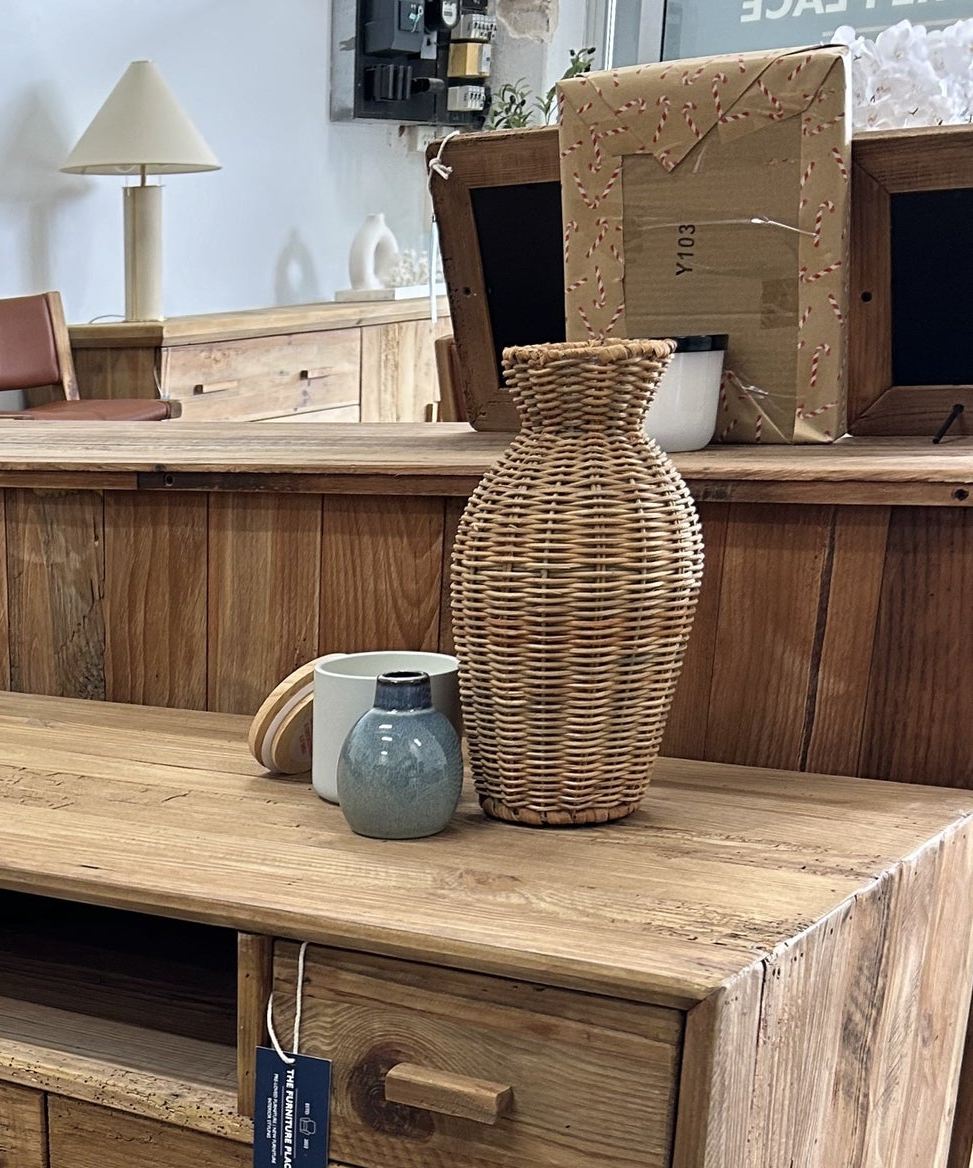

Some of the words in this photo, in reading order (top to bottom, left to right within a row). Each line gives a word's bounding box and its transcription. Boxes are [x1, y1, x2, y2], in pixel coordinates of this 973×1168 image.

[675, 224, 696, 276] Y103
[286, 1069, 295, 1089] THE
[284, 1090, 294, 1145] FURNITURE
